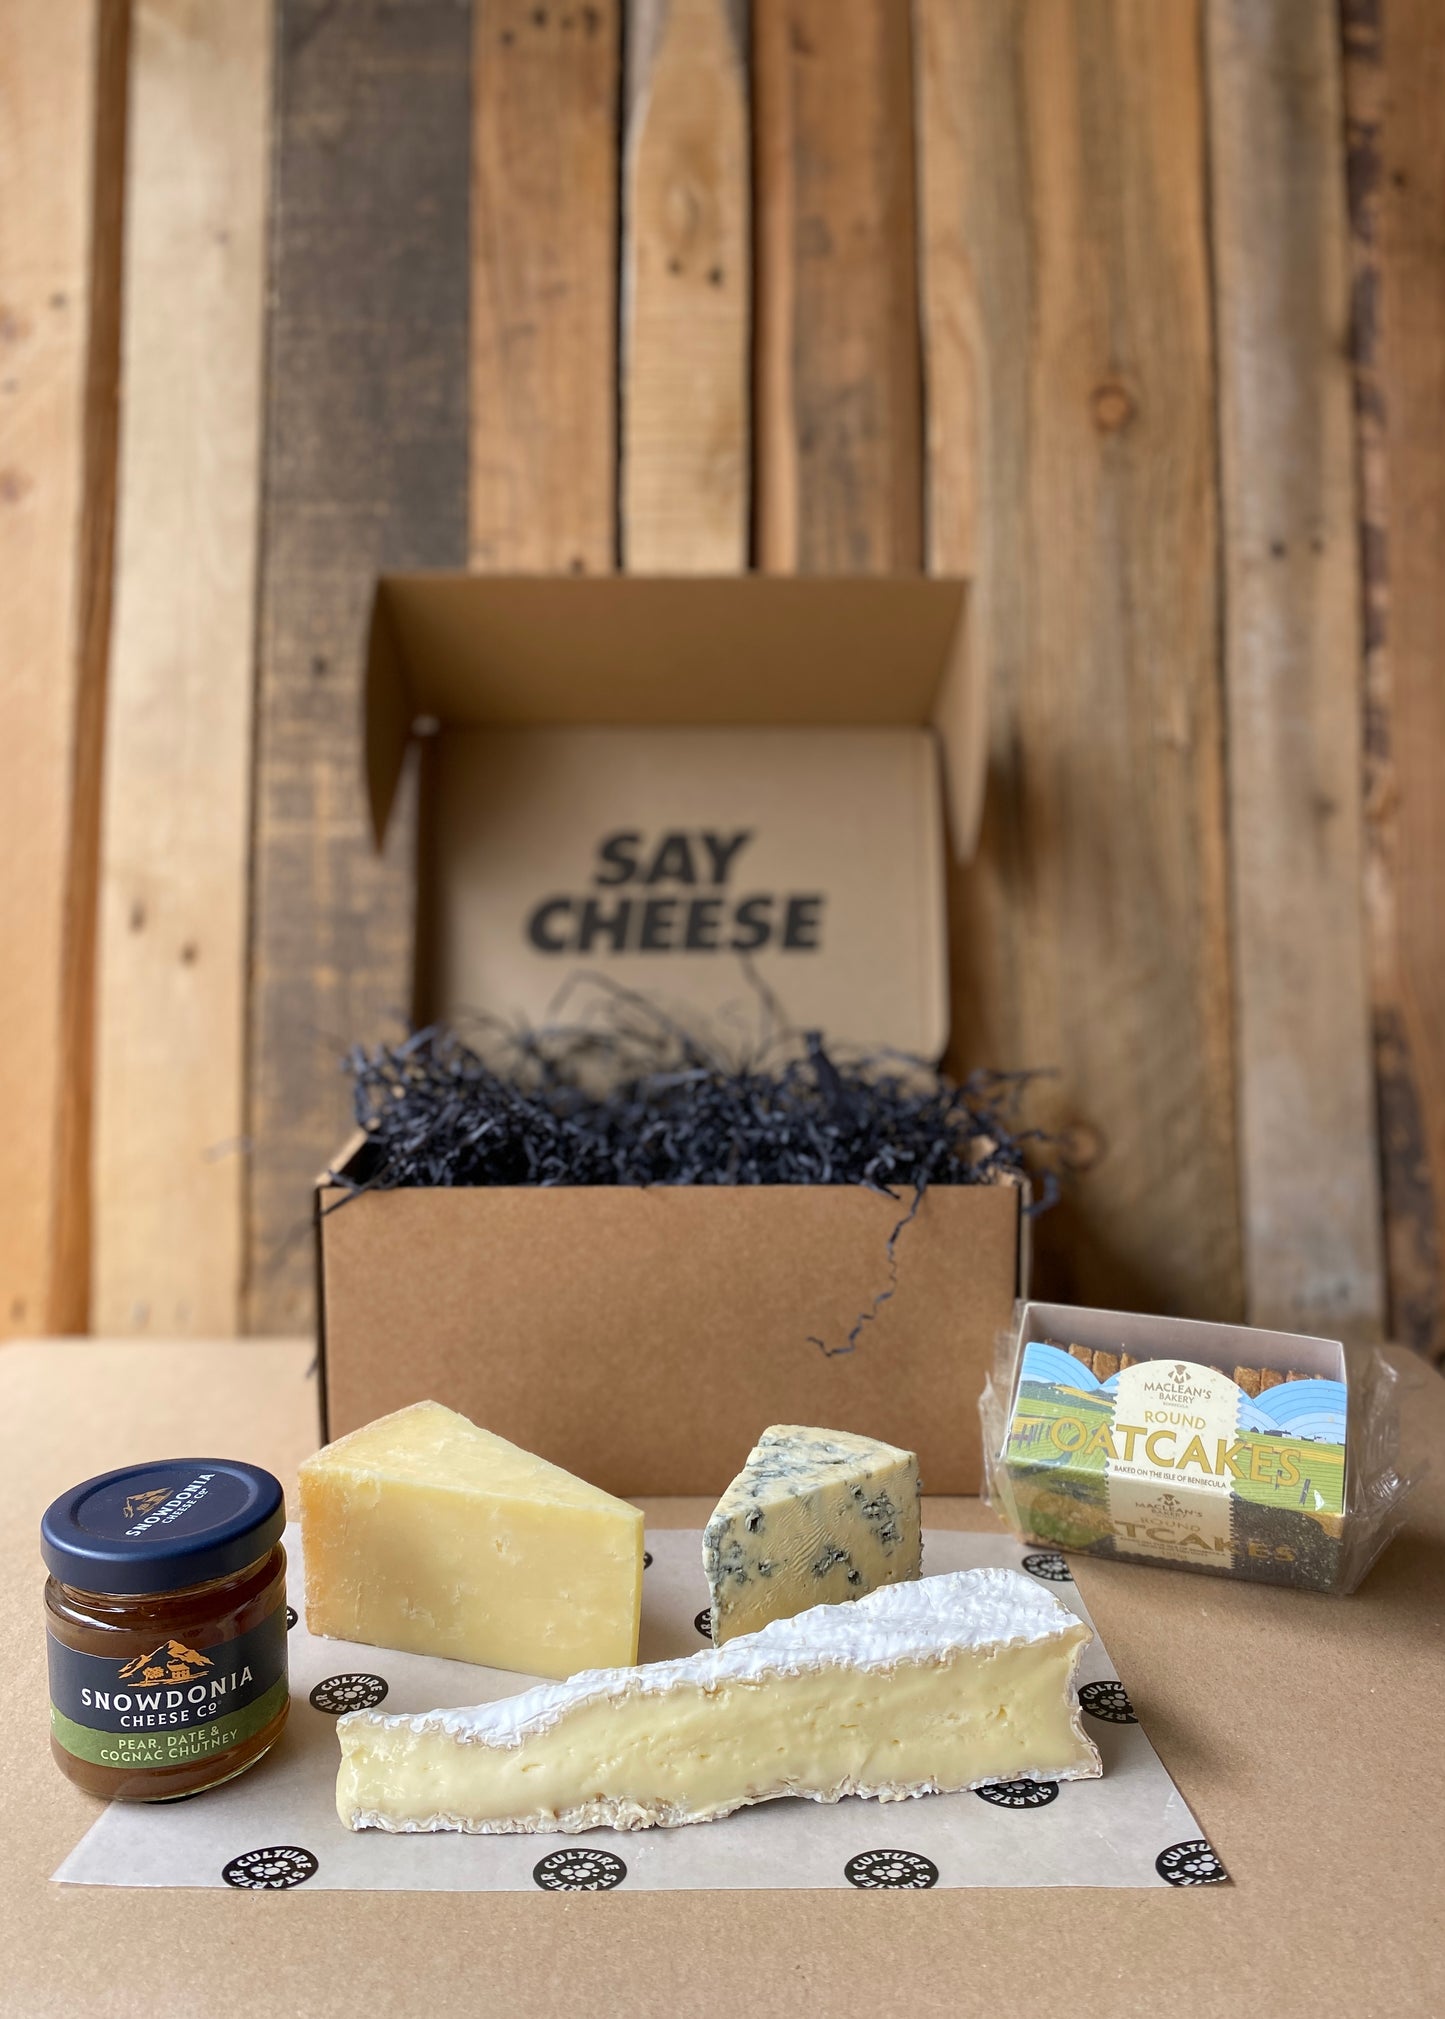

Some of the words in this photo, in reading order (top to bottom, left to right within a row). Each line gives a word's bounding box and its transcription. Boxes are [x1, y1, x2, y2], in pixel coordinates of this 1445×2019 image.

[596, 829, 753, 886] SAY
[527, 894, 825, 954] CHEESE
[1144, 1382, 1212, 1400] MACLEAN'S
[1158, 1392, 1195, 1405] BAKERY
[1144, 1410, 1207, 1430] ROUND
[1049, 1416, 1303, 1488] OATCAKES
[1114, 1465, 1137, 1475] BAKED
[1136, 1468, 1149, 1476] ON
[1149, 1470, 1163, 1479] THE
[1162, 1472, 1176, 1481] ISLE
[1176, 1474, 1187, 1483] OF
[1187, 1475, 1227, 1489] BENBECULA
[125, 1473, 216, 1537] SNOWDONIA
[162, 1498, 198, 1525] CHEESE
[1135, 1501, 1203, 1518] MACLEAN'S
[1140, 1517, 1201, 1532] ROUND
[80, 1665, 254, 1712] SNOWDONIA
[321, 1675, 383, 1692] CULTURE
[315, 1693, 379, 1711] STARTER
[120, 1710, 190, 1727] CHEESE
[100, 1749, 164, 1762] COGNAC
[168, 1729, 238, 1759] CHUTNEY
[118, 1738, 162, 1751] PEAR,
[167, 1729, 206, 1746] DATE
[210, 1725, 220, 1736] &
[981, 1785, 1052, 1805] STARTER
[236, 1849, 312, 1869] CULTURE
[544, 1851, 621, 1871] CULTURE
[852, 1852, 930, 1871] CULTURE
[228, 1869, 306, 1890] STARTER
